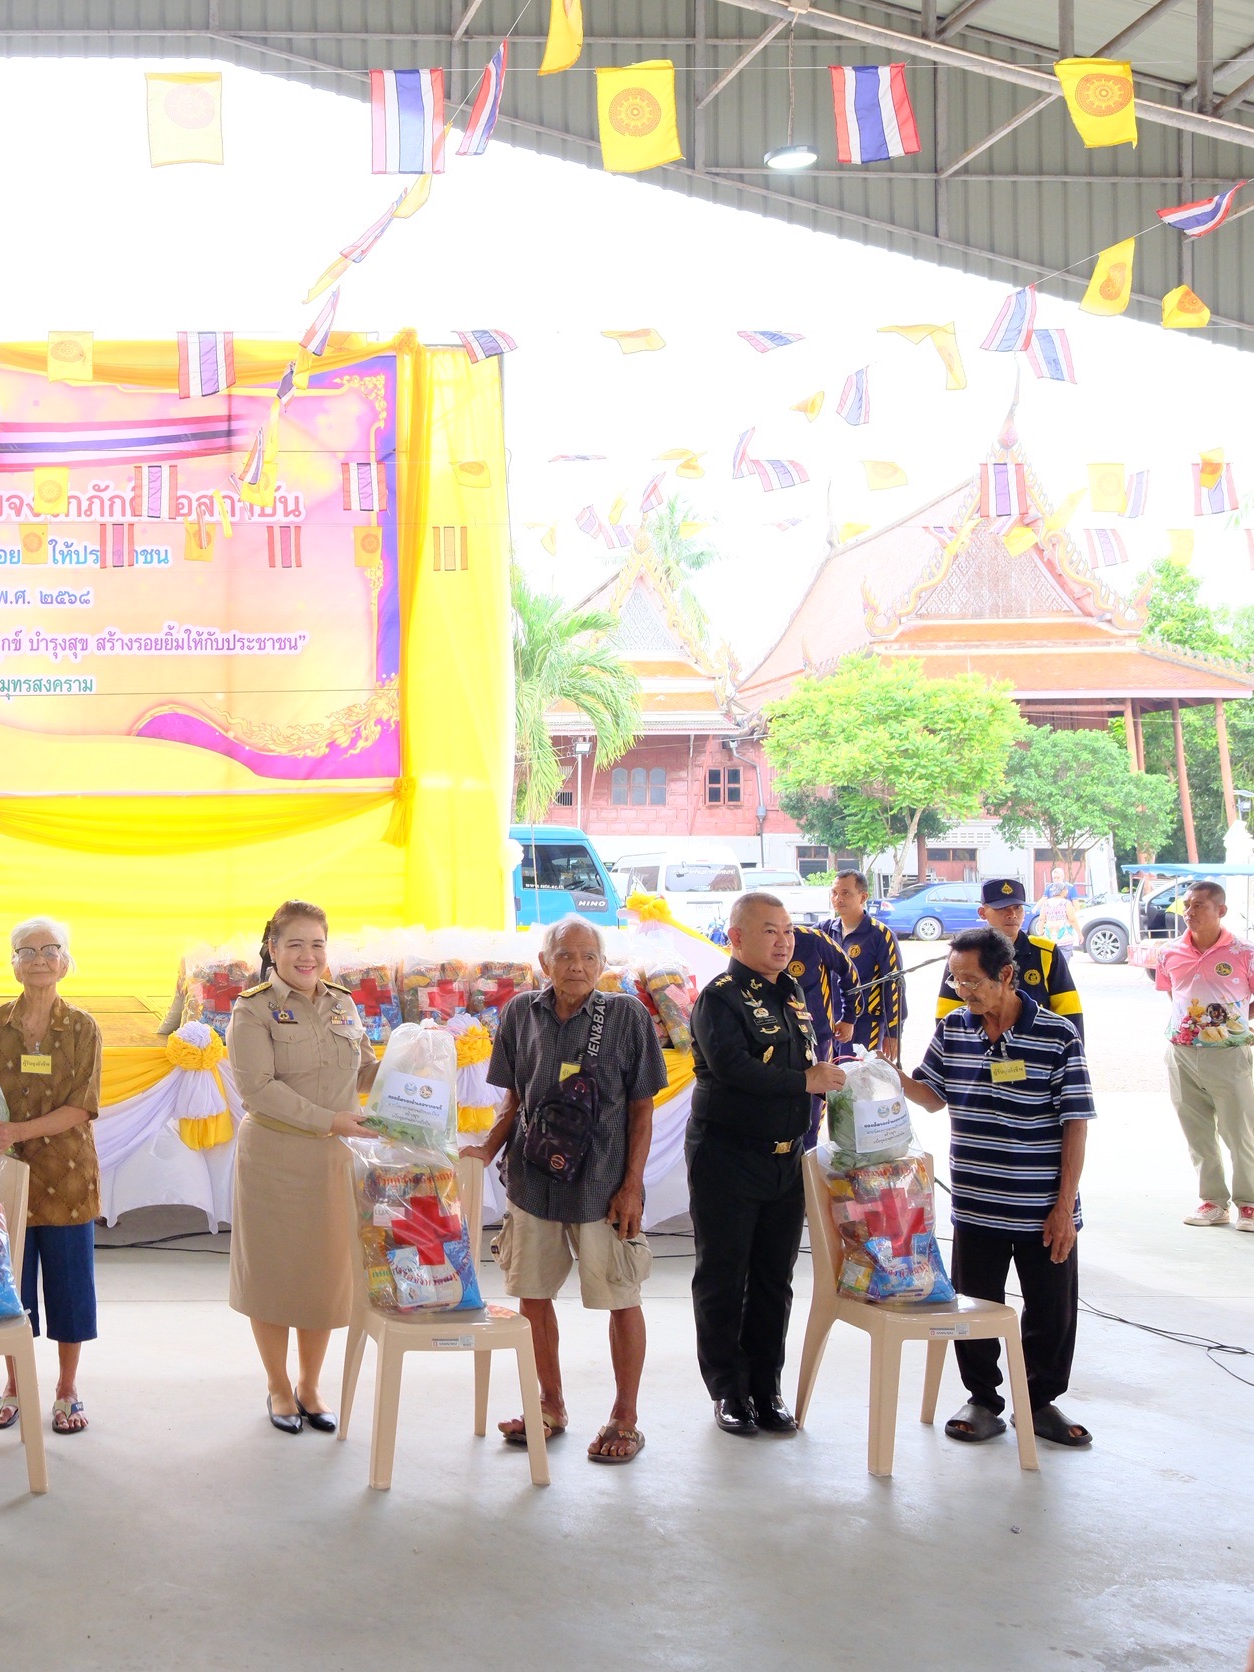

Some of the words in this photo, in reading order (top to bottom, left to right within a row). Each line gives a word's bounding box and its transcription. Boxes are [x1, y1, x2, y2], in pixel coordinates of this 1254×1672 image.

[39, 587, 91, 606] ๒๕๖๘
[29, 632, 88, 661] บำรุงสุข
[96, 623, 307, 653] สร้างรอยยิ้มให้กับประชาชน”
